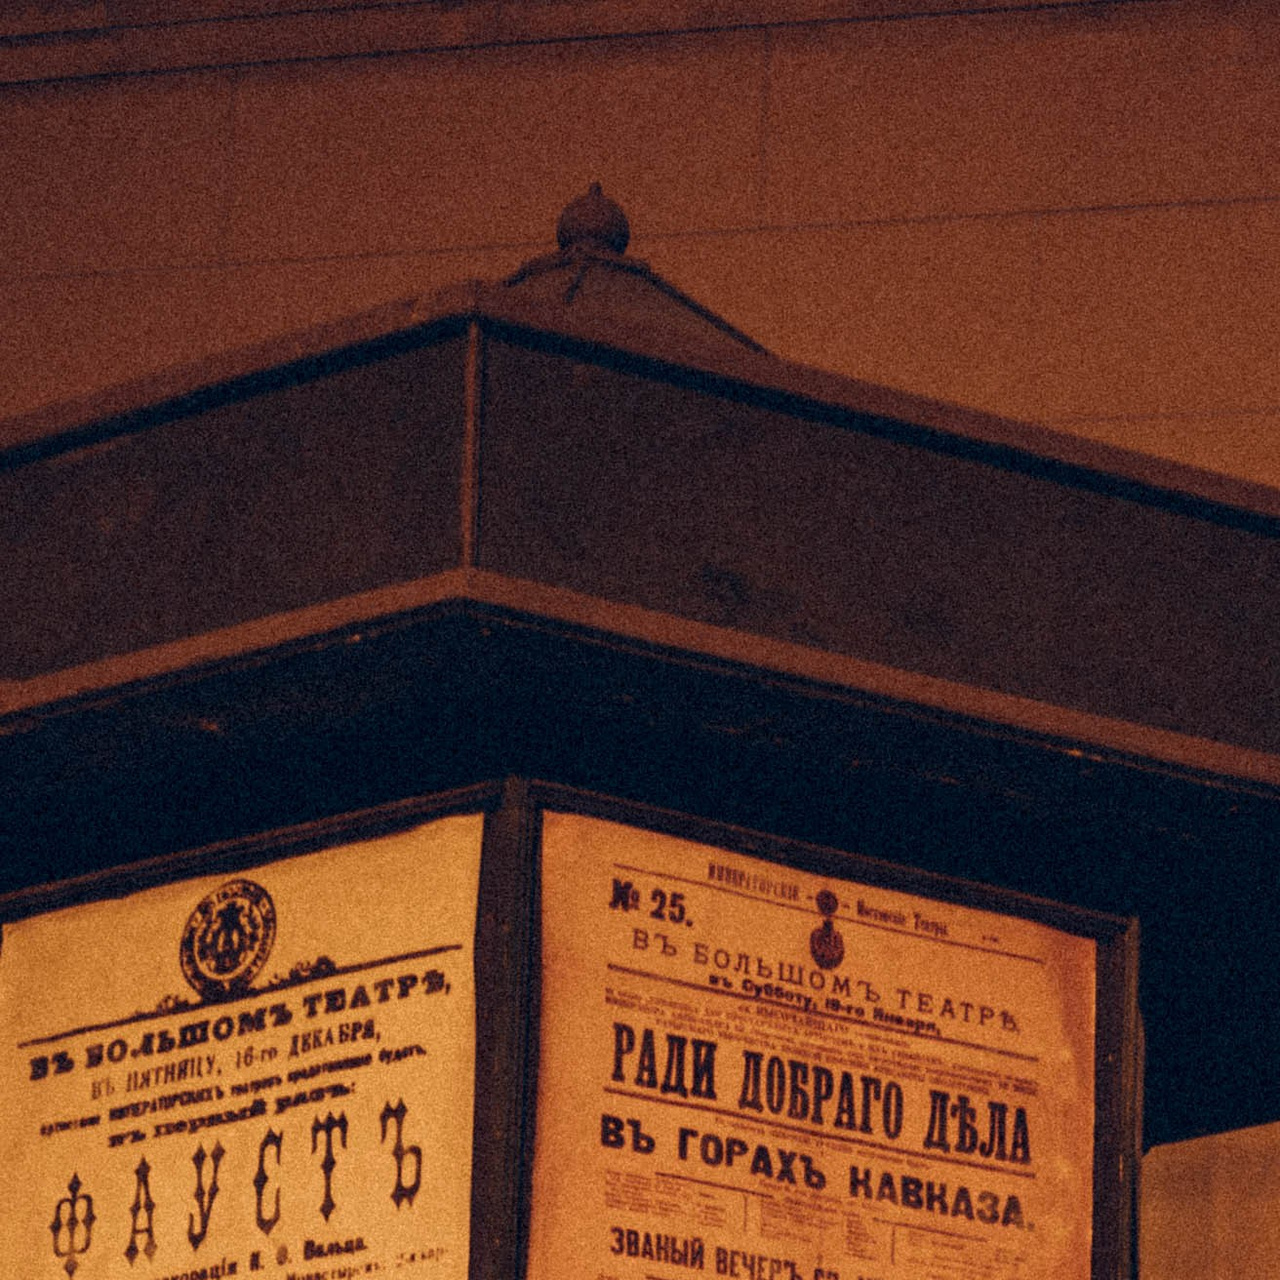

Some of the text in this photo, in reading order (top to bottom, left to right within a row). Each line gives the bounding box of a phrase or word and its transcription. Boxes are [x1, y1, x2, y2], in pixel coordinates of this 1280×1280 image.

[608, 878, 692, 927] № 25.
[632, 927, 677, 957] ВЪ
[692, 941, 880, 1003] БОЛЬШОМЪ
[30, 968, 450, 1080] ВЪ БОЛЬШОМЪ ТЕАТРѢ,
[288, 1018, 380, 1057] ДЕКАБРЯ,
[611, 1021, 717, 1100] РАДИ
[738, 1049, 903, 1139] ДОБРАГО
[923, 1089, 1031, 1165] ДѢЛА
[48, 1097, 422, 1280] ФАУСТЪ
[600, 1113, 655, 1154] ВЪ
[677, 1127, 826, 1190] ГОРАХЪ
[849, 1165, 1034, 1230] КАВКАЗА.
[610, 1226, 704, 1270] ЗВАНЫЙ
